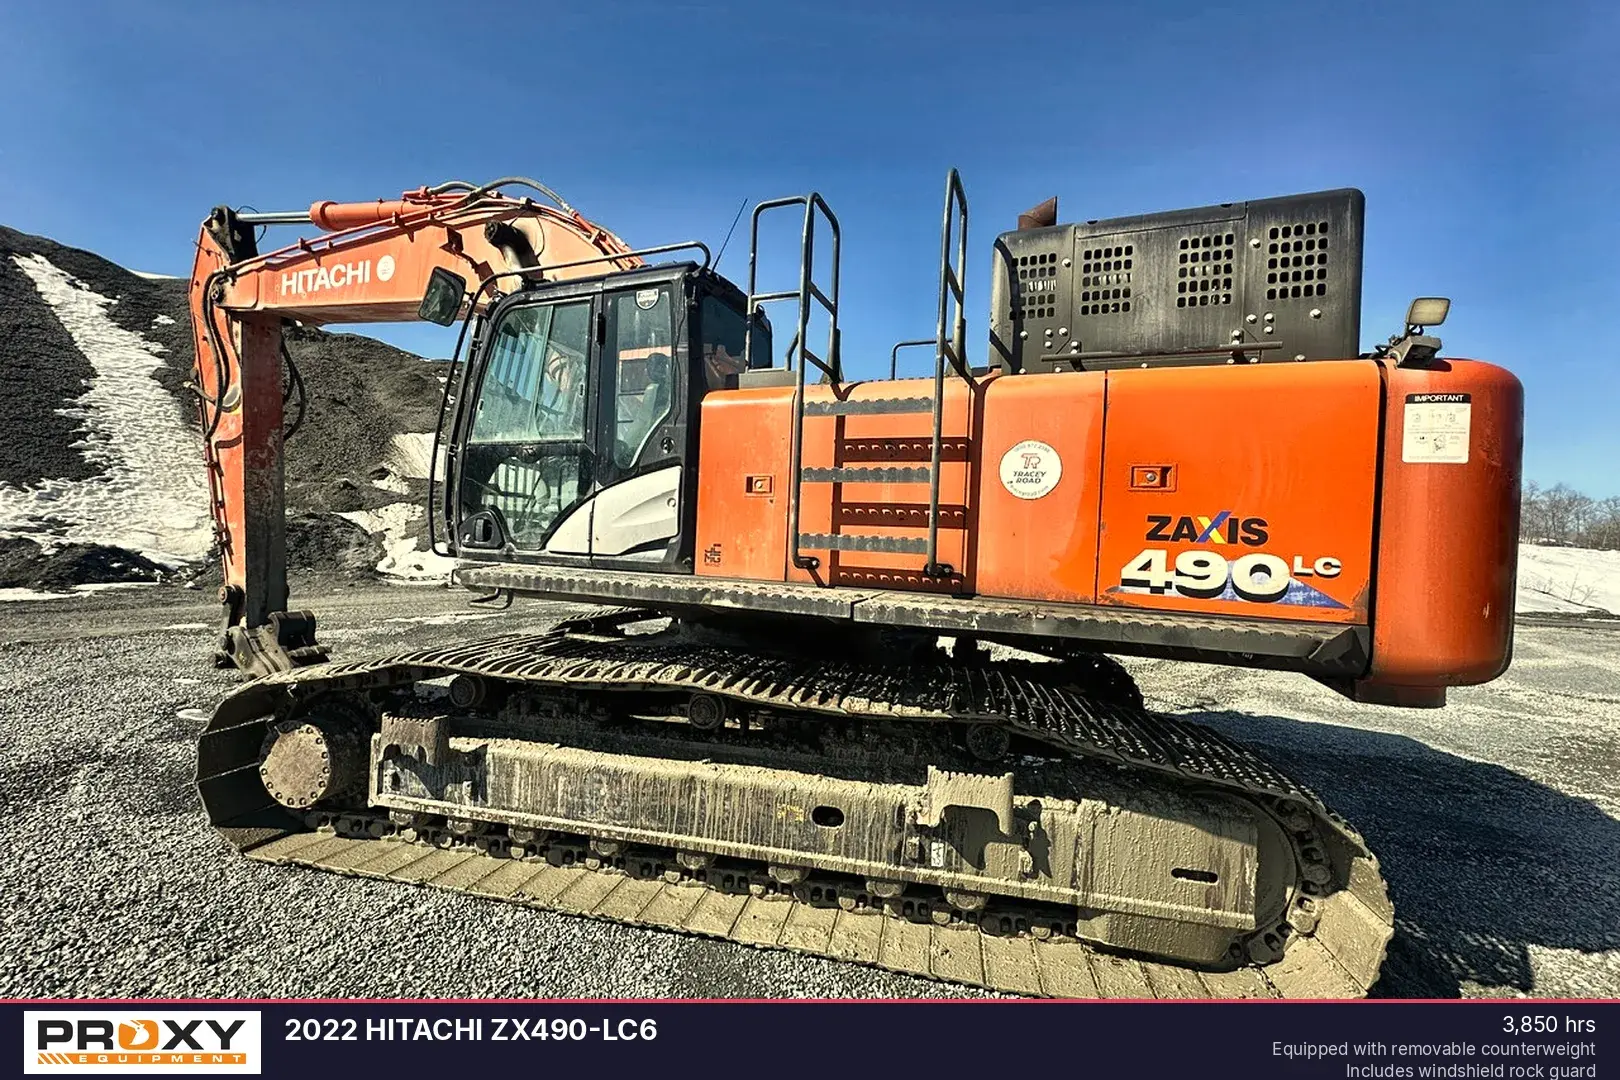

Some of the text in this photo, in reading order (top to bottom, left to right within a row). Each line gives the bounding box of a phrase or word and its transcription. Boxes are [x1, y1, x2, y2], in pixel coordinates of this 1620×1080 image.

[281, 259, 371, 296] HITACHI
[1414, 394, 1464, 402] IMPORTANT
[1013, 470, 1047, 478] TRACEY
[1145, 510, 1269, 547] ZAXIS
[1120, 549, 1291, 603] 490
